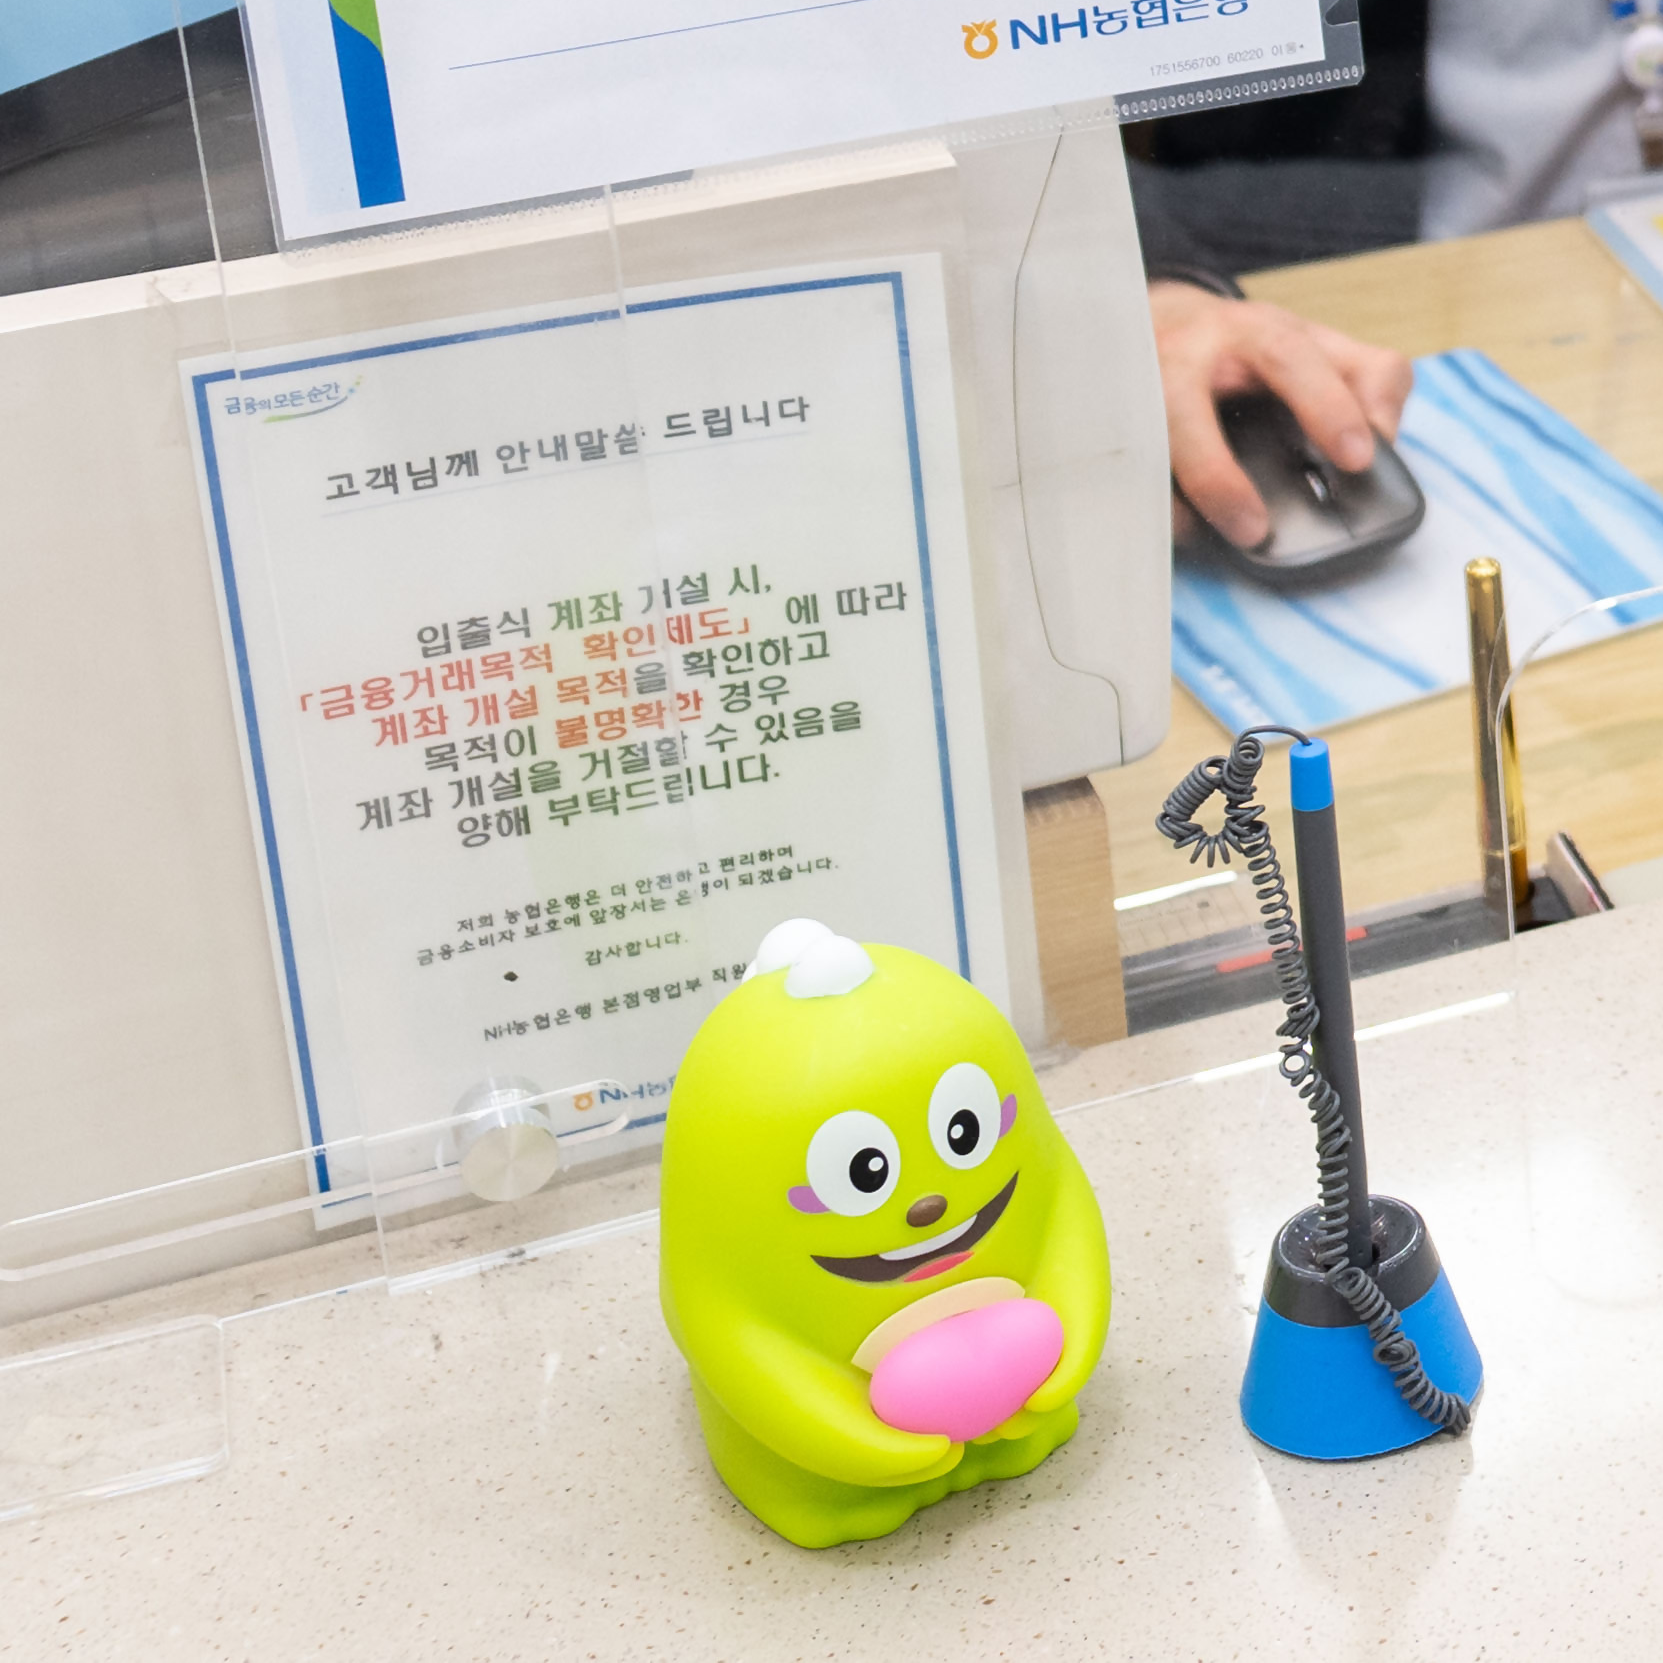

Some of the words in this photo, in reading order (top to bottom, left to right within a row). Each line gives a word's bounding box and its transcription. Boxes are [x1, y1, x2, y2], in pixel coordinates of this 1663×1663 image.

[1150, 55, 1221, 76] 1751556700
[1227, 48, 1264, 64] 60220
[274, 390, 305, 409] 모든
[307, 382, 340, 403] 순간
[325, 449, 480, 502] 고객님께
[663, 395, 810, 440] 드립니다
[300, 642, 554, 721] 「금융거래목적
[785, 593, 820, 625] 에
[836, 582, 907, 617] 따라
[416, 607, 532, 659] 입출식
[547, 590, 623, 631] 계좌
[728, 564, 771, 597] 시,
[371, 703, 449, 748] 계좌
[464, 685, 539, 727] 개설
[556, 661, 667, 706] 목적을
[682, 630, 830, 679] 확인하고
[424, 725, 538, 772] 목적이
[555, 688, 703, 749] 불명확한
[719, 675, 790, 714] 경우
[356, 787, 434, 831] 계좌
[448, 759, 562, 810] 개설을
[704, 723, 738, 753] 수
[754, 700, 862, 745] 있음을
[457, 803, 532, 849] 양해
[548, 752, 780, 827] 부탁드립니다.
[417, 928, 516, 966] 금융소비자
[525, 912, 582, 939] 보호에
[589, 896, 667, 926] 앞장서는
[738, 856, 840, 886] 되겠습니다.
[457, 913, 495, 933] 저희
[504, 889, 602, 925] 농협은행은
[610, 883, 627, 898] 더
[635, 861, 711, 896] 안전하고
[719, 844, 795, 874] 편리하며
[585, 931, 689, 967] 감사합니다.
[602, 977, 703, 1015] 본점영업부
